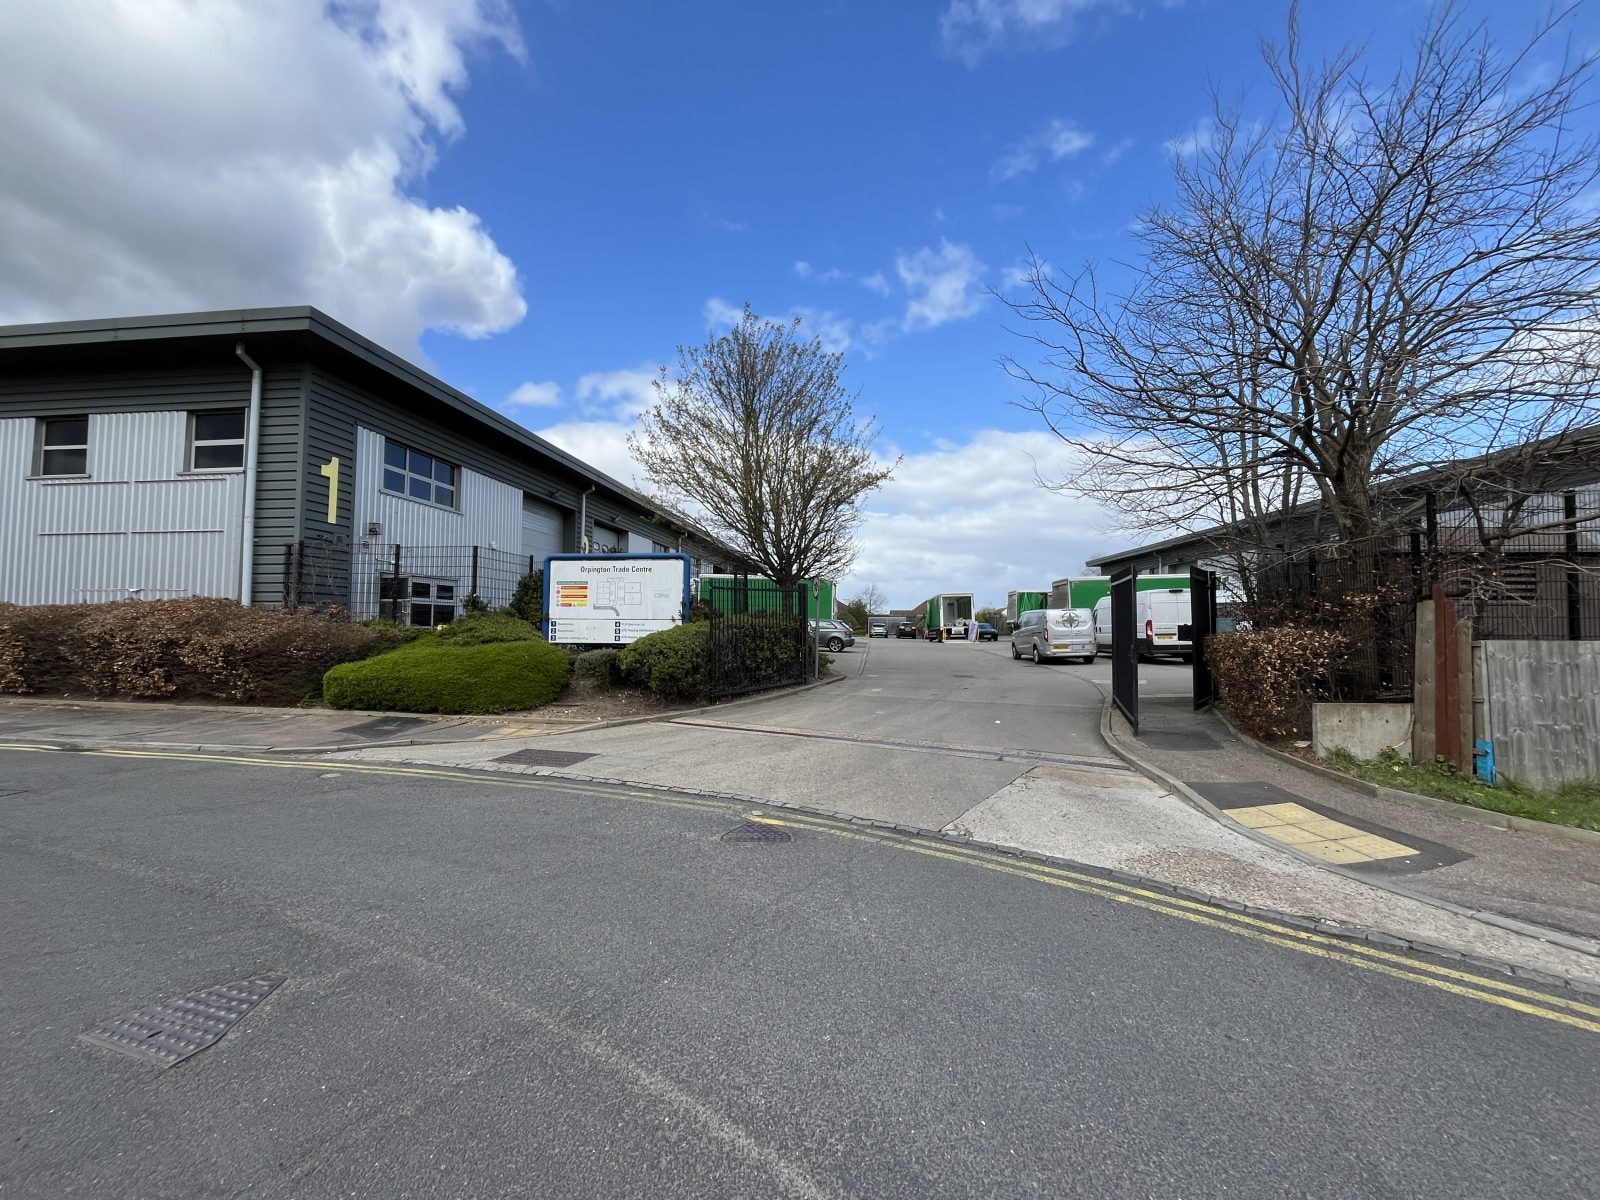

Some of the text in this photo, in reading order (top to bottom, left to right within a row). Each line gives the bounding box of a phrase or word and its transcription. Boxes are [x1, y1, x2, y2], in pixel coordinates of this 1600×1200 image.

[321, 456, 339, 524] 1
[580, 565, 653, 574] Orpington Trade Centre
